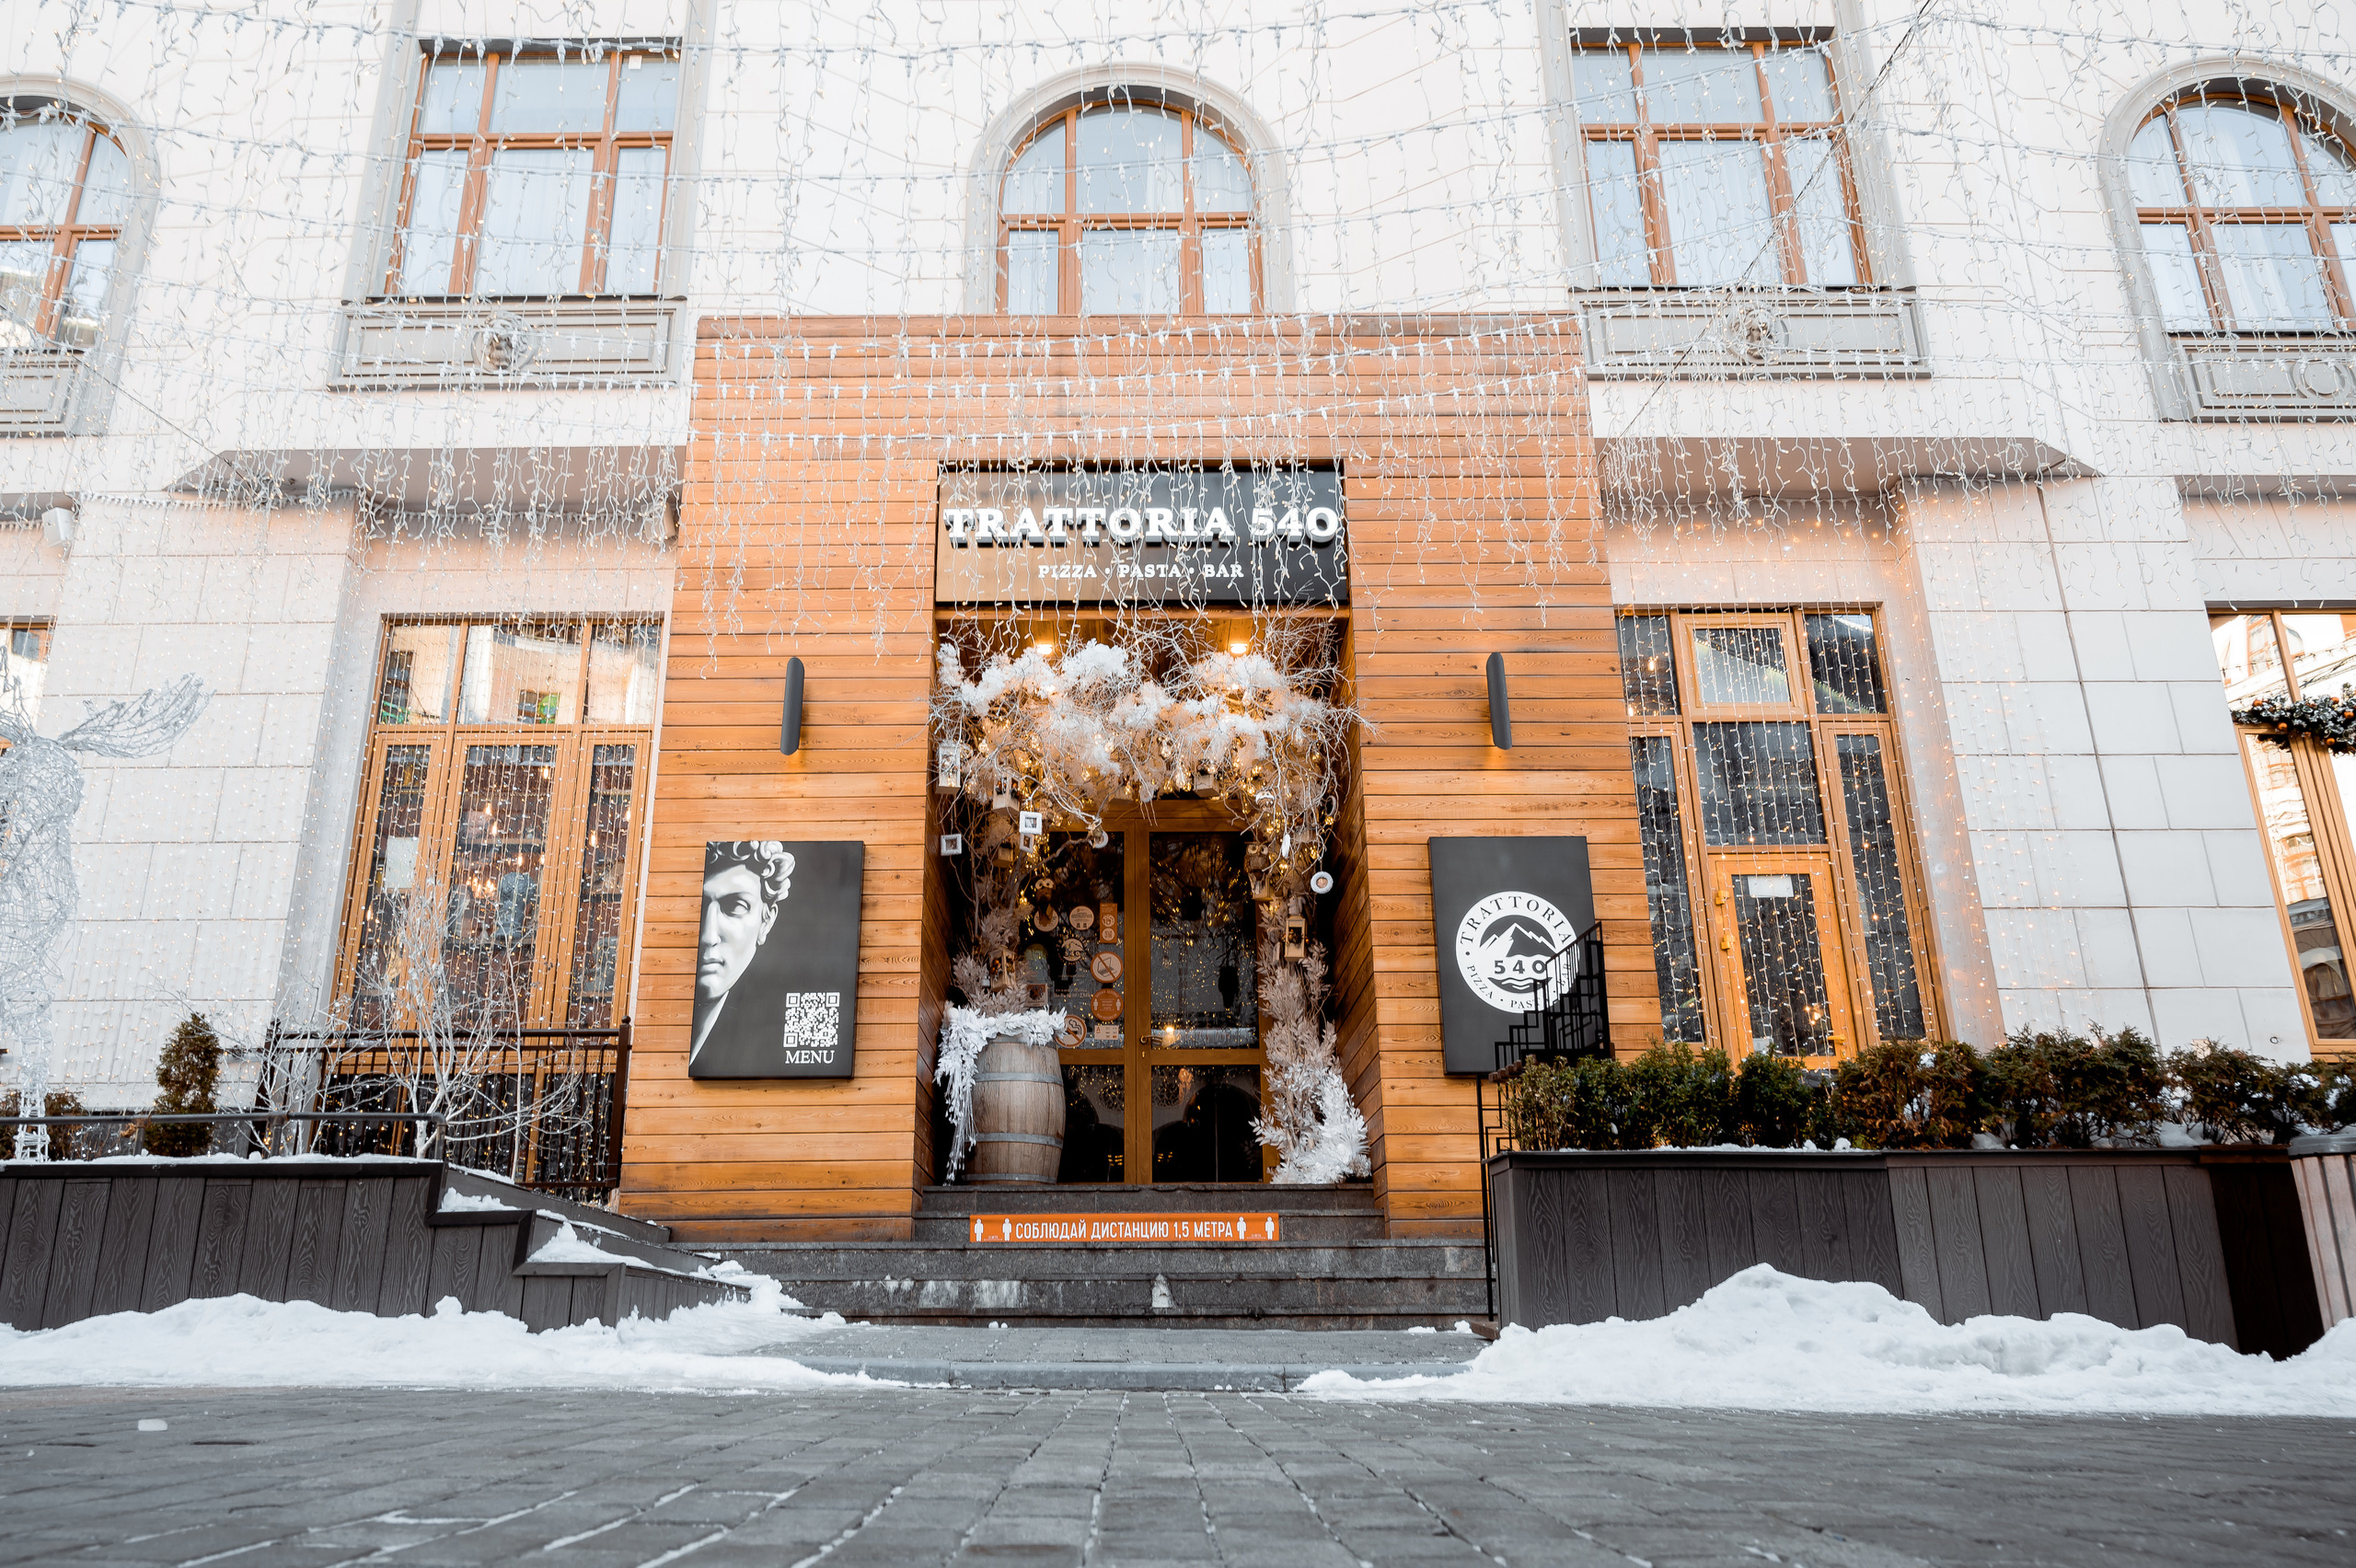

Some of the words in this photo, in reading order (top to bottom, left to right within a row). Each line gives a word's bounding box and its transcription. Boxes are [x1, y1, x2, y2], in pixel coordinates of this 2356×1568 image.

[943, 508, 1236, 547] TRATTORIA
[1251, 507, 1338, 543] 540
[1038, 565, 1097, 578] PIZZA
[1118, 564, 1182, 578] PASTA
[1203, 564, 1244, 578] BAR
[1460, 895, 1572, 945] TRATTORIA
[1494, 960, 1546, 974] 540
[1467, 964, 1494, 999] PIZZA
[785, 1050, 835, 1064] MENU
[1015, 1218, 1087, 1240] СОБЛЮДАЙ
[1091, 1221, 1169, 1239] ДИСТАНЦИЮ
[1173, 1221, 1190, 1239] 1,5
[1194, 1220, 1233, 1238] МЕТРА
